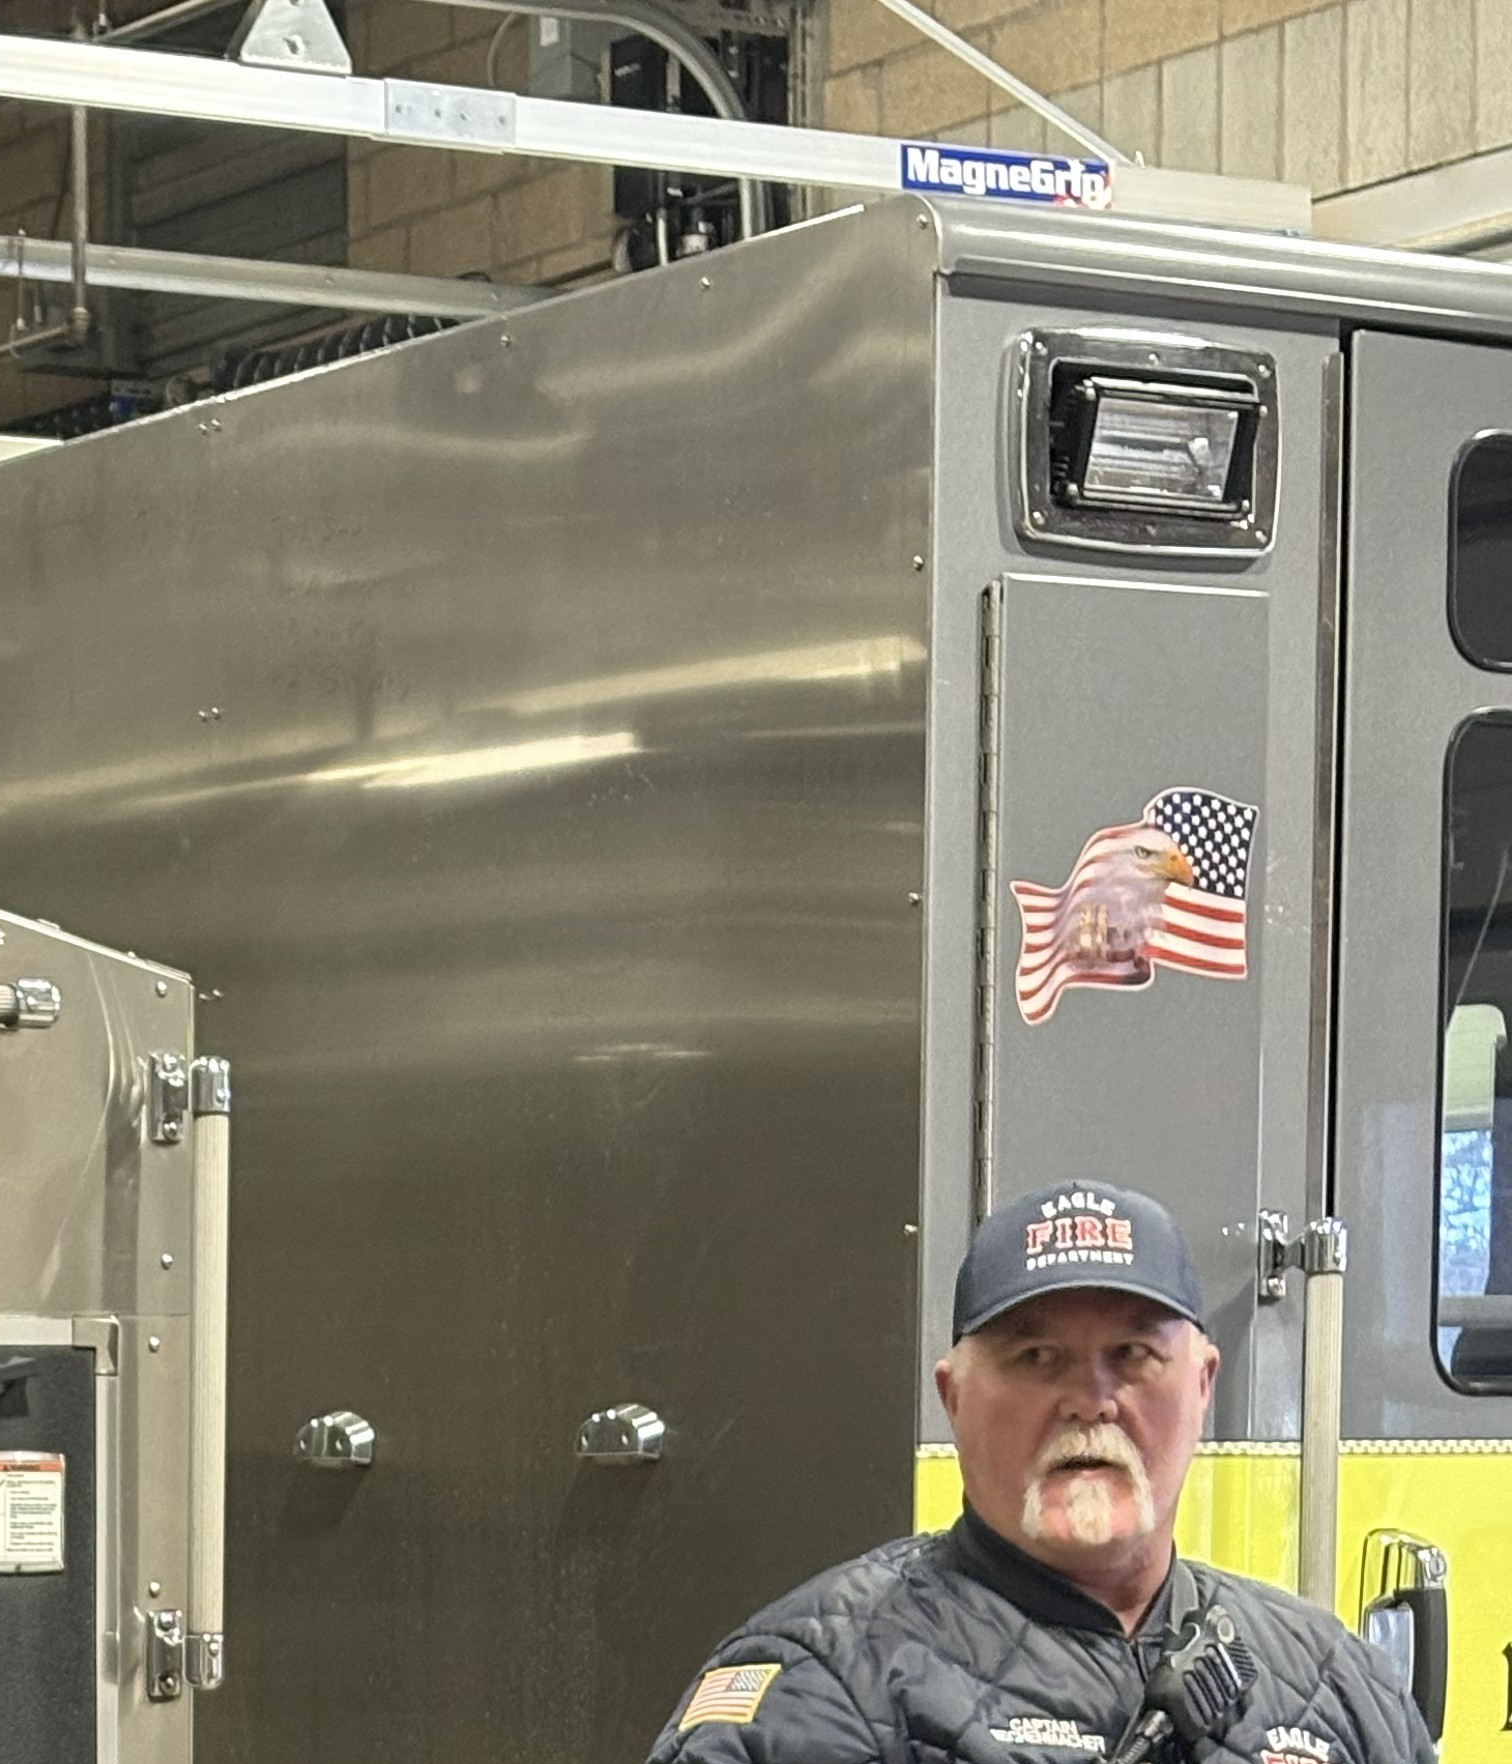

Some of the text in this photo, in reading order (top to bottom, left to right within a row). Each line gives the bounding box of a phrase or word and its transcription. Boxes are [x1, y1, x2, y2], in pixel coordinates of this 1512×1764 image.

[907, 147, 1105, 203] MagneGrip
[1040, 1191, 1116, 1219] EAGLE
[1025, 1215, 1134, 1255] FIRE
[1025, 1250, 1135, 1271] DEPARTMENT
[1009, 1717, 1080, 1735] CAPTAIN
[1265, 1725, 1331, 1762] EAGLE
